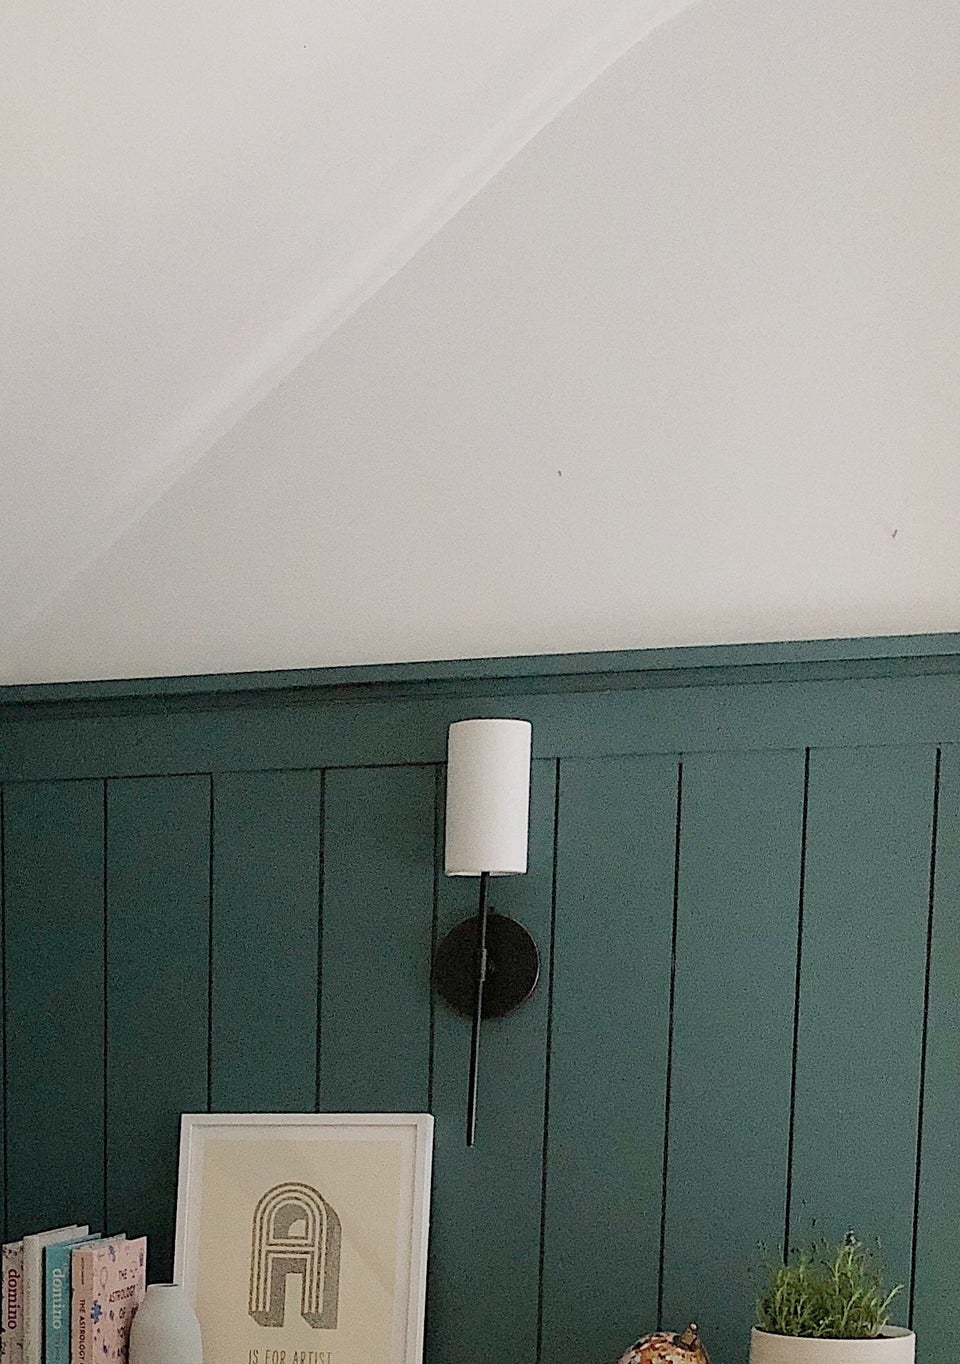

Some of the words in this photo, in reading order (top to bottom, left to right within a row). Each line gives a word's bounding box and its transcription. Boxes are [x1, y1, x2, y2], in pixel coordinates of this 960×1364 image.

[248, 1181, 342, 1329] A
[7, 1268, 20, 1330] domino
[52, 1268, 66, 1329] domino
[78, 1315, 86, 1361] ASTROLOGY
